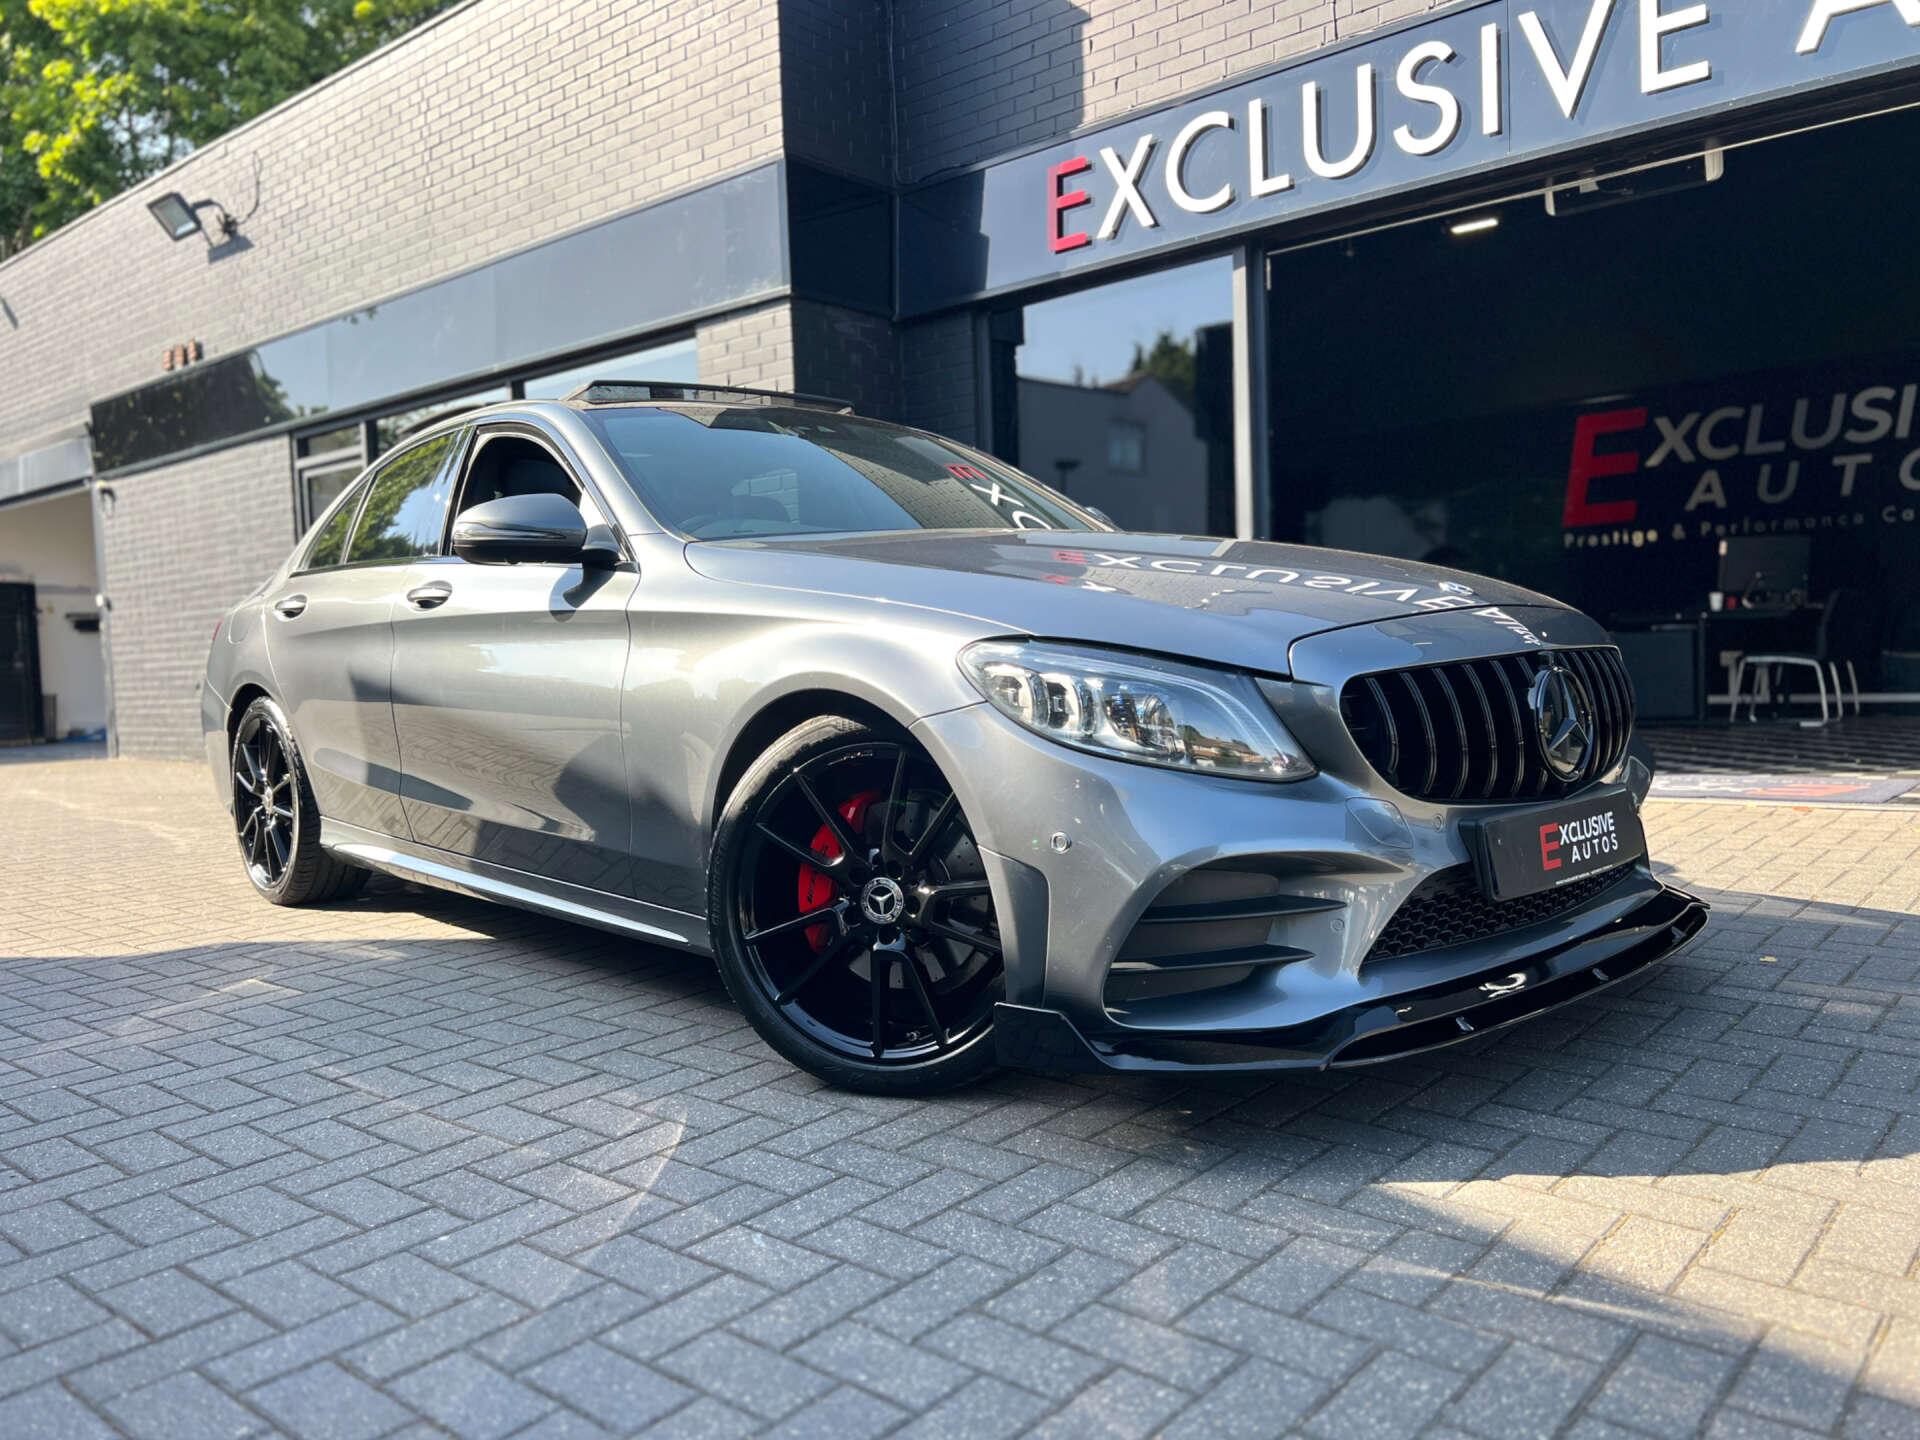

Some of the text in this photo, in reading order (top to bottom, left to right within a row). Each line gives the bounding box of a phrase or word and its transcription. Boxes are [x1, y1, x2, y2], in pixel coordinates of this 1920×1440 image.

[1048, 0, 1711, 253] EXCLUSIVE
[1671, 522, 1686, 541] &
[1539, 811, 1616, 871] EXCLUSIVE
[1571, 833, 1619, 863] AUTOS
